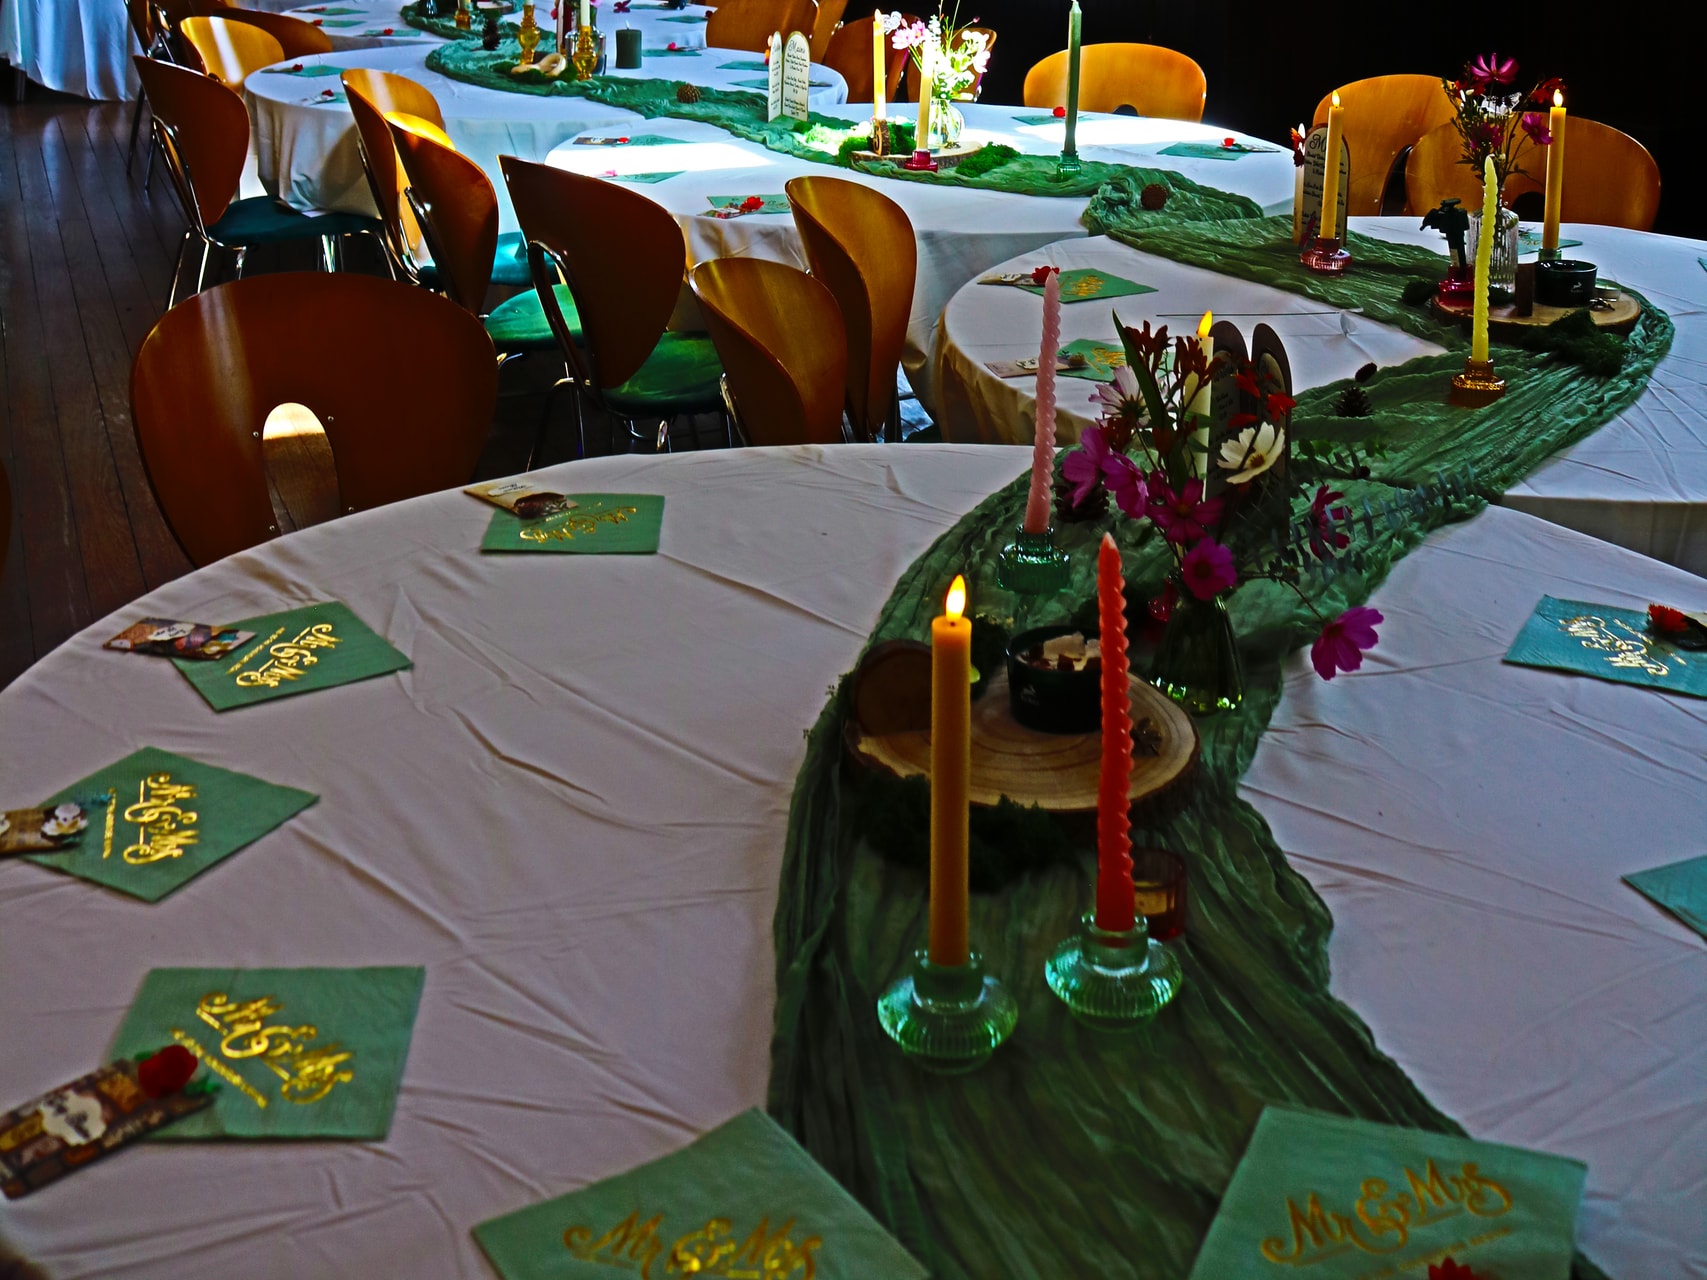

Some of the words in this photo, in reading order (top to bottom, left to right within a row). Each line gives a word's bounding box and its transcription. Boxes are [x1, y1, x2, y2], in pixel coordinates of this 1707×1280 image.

[563, 1209, 664, 1280] Mr
[666, 1217, 736, 1280] &
[730, 1216, 823, 1280] Mrs
[1261, 1191, 1354, 1264] Mr
[1352, 1177, 1412, 1255] &
[1404, 1156, 1513, 1217] Mrs
